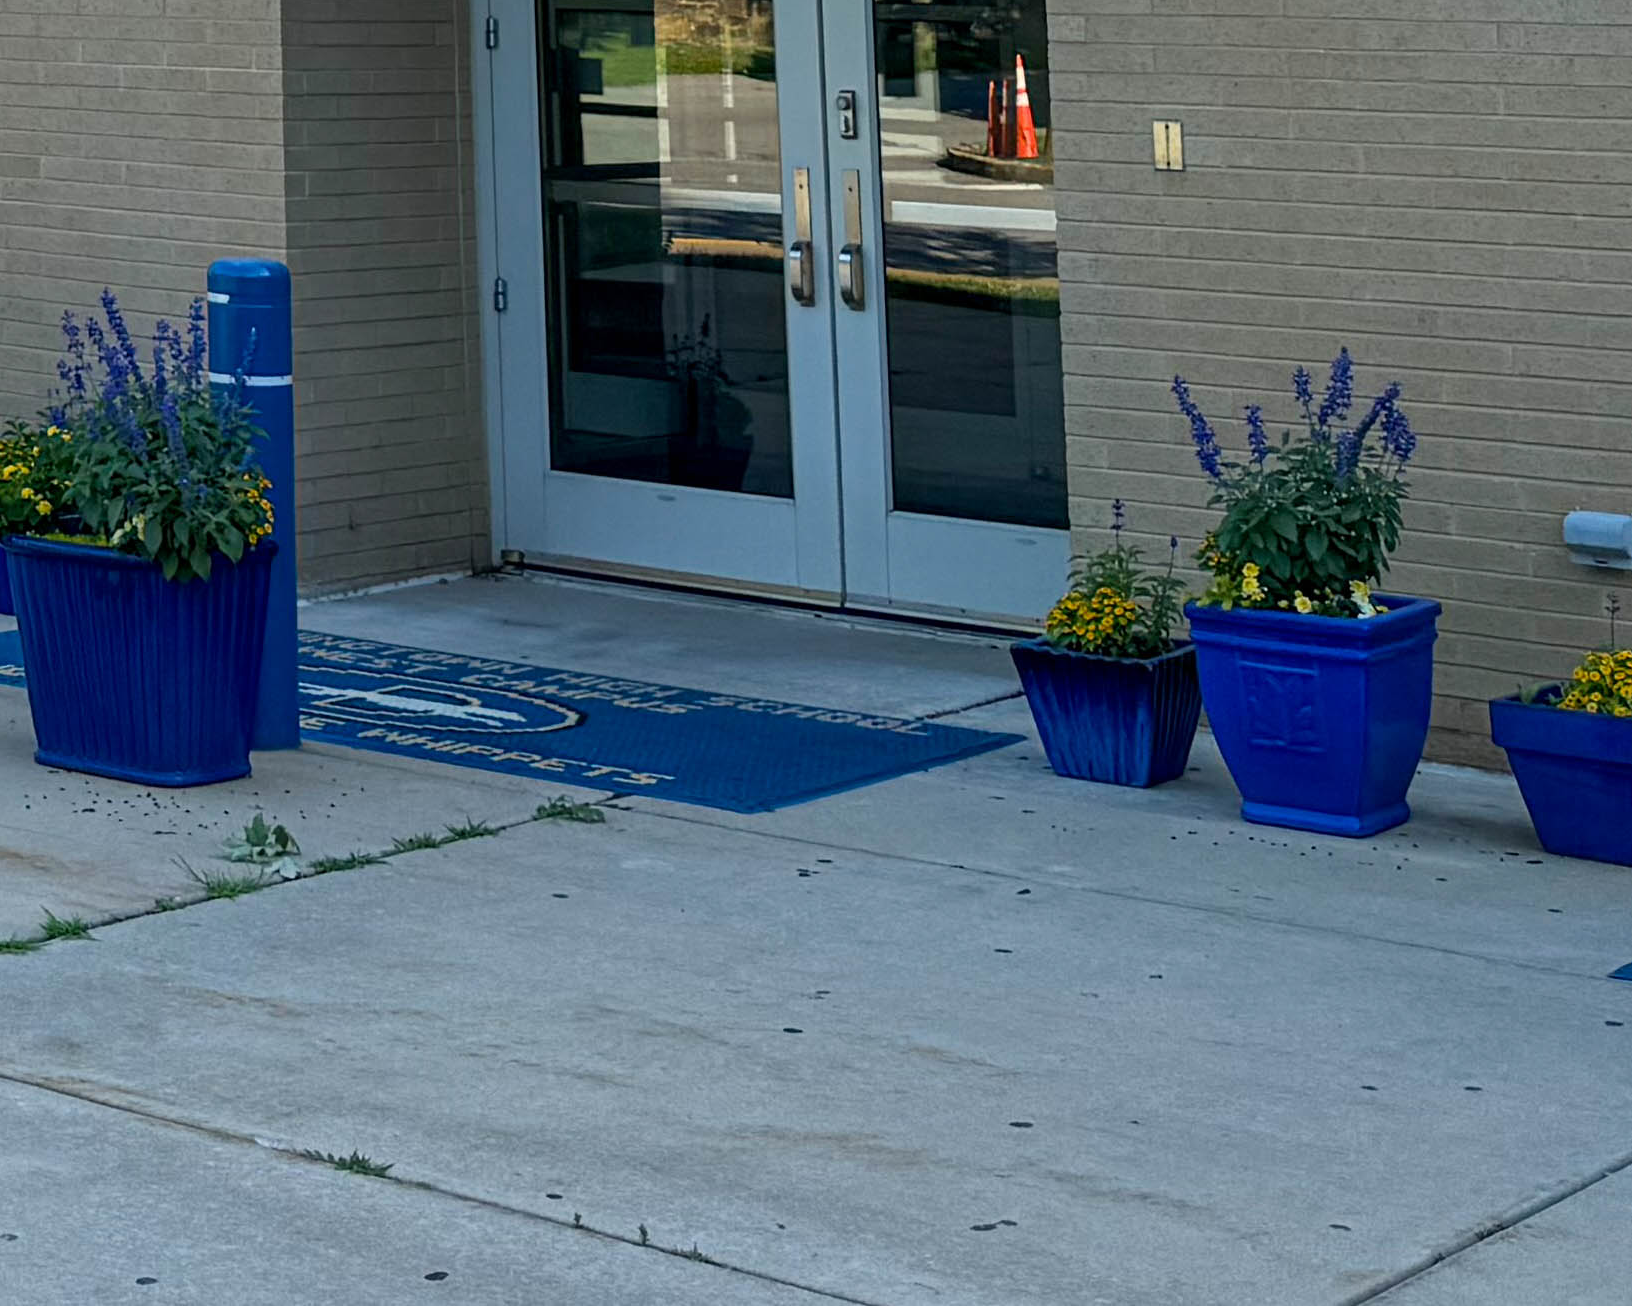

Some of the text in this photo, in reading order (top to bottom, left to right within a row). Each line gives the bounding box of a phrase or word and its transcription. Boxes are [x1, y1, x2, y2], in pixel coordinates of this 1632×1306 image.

[460, 673, 704, 715] CAMPUS
[543, 672, 681, 698] HIGH
[694, 695, 928, 736] SCHOOL
[356, 727, 677, 786] WHIPPETS
